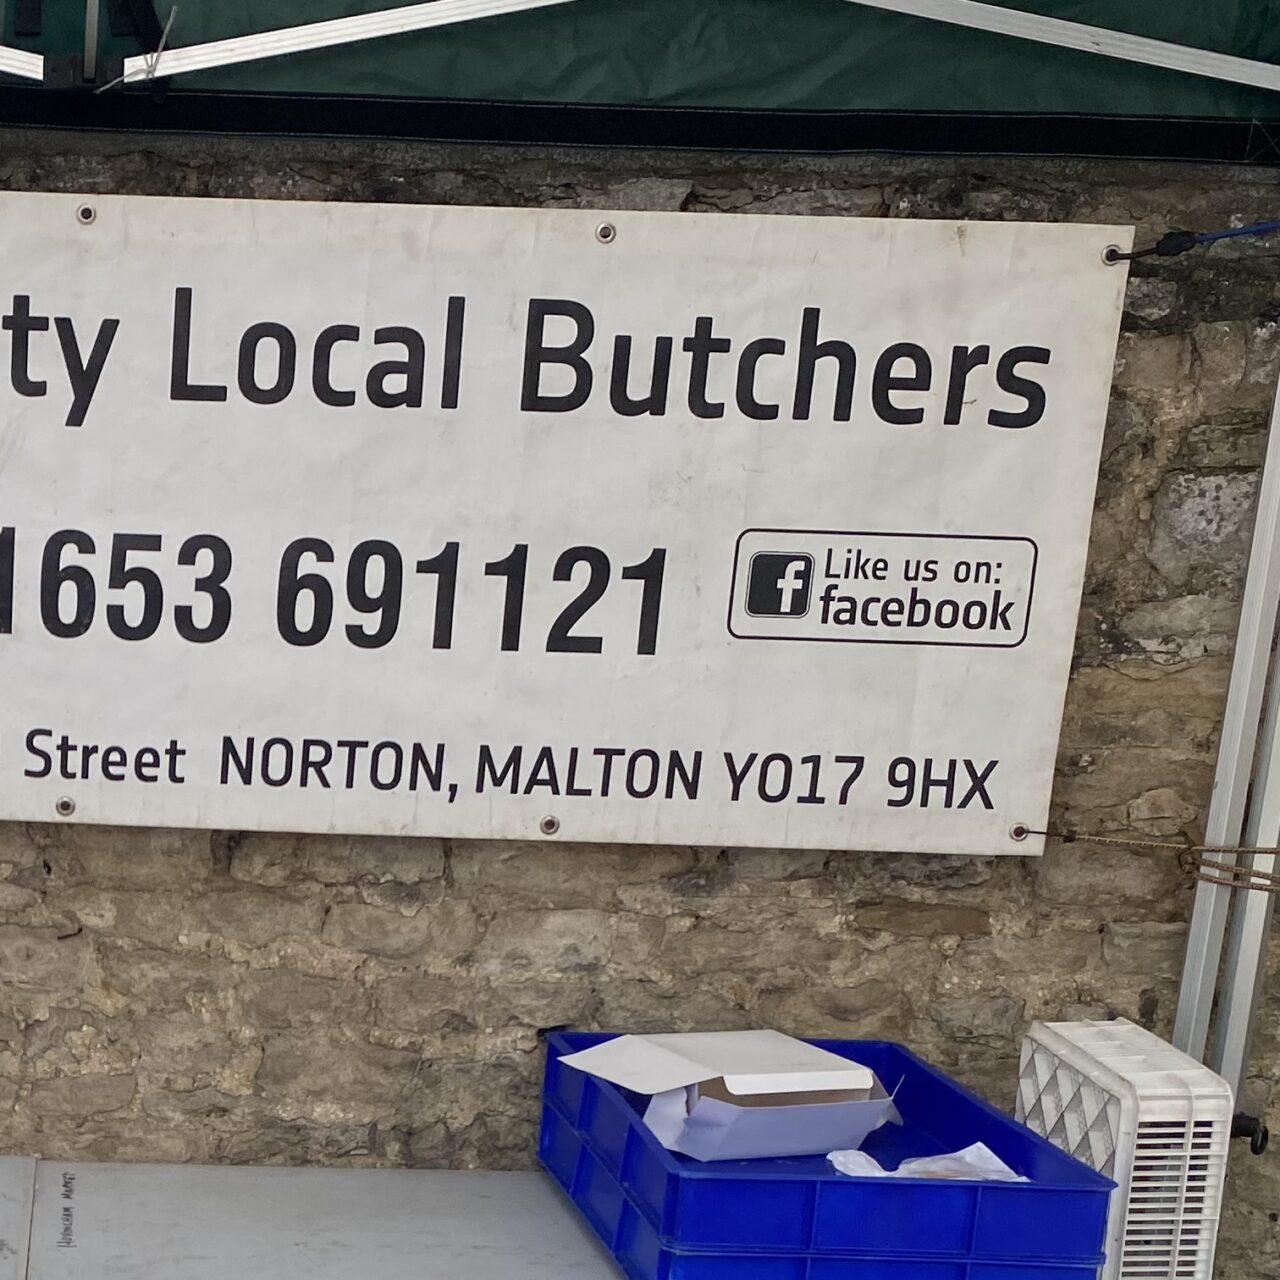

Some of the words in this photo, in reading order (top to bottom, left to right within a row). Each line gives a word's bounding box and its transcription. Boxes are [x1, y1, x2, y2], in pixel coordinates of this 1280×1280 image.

[169, 287, 466, 410] Local
[520, 297, 1052, 429] Butchers
[275, 537, 667, 656] 691121
[819, 583, 1015, 631] facebook
[824, 547, 889, 581] Like
[903, 559, 939, 582] us
[953, 560, 1003, 584] on:
[23, 727, 188, 785] Street
[220, 735, 458, 805] NORTON,
[475, 743, 702, 800] MALTON
[723, 751, 864, 805] YO17
[886, 758, 1000, 810] 9HX
